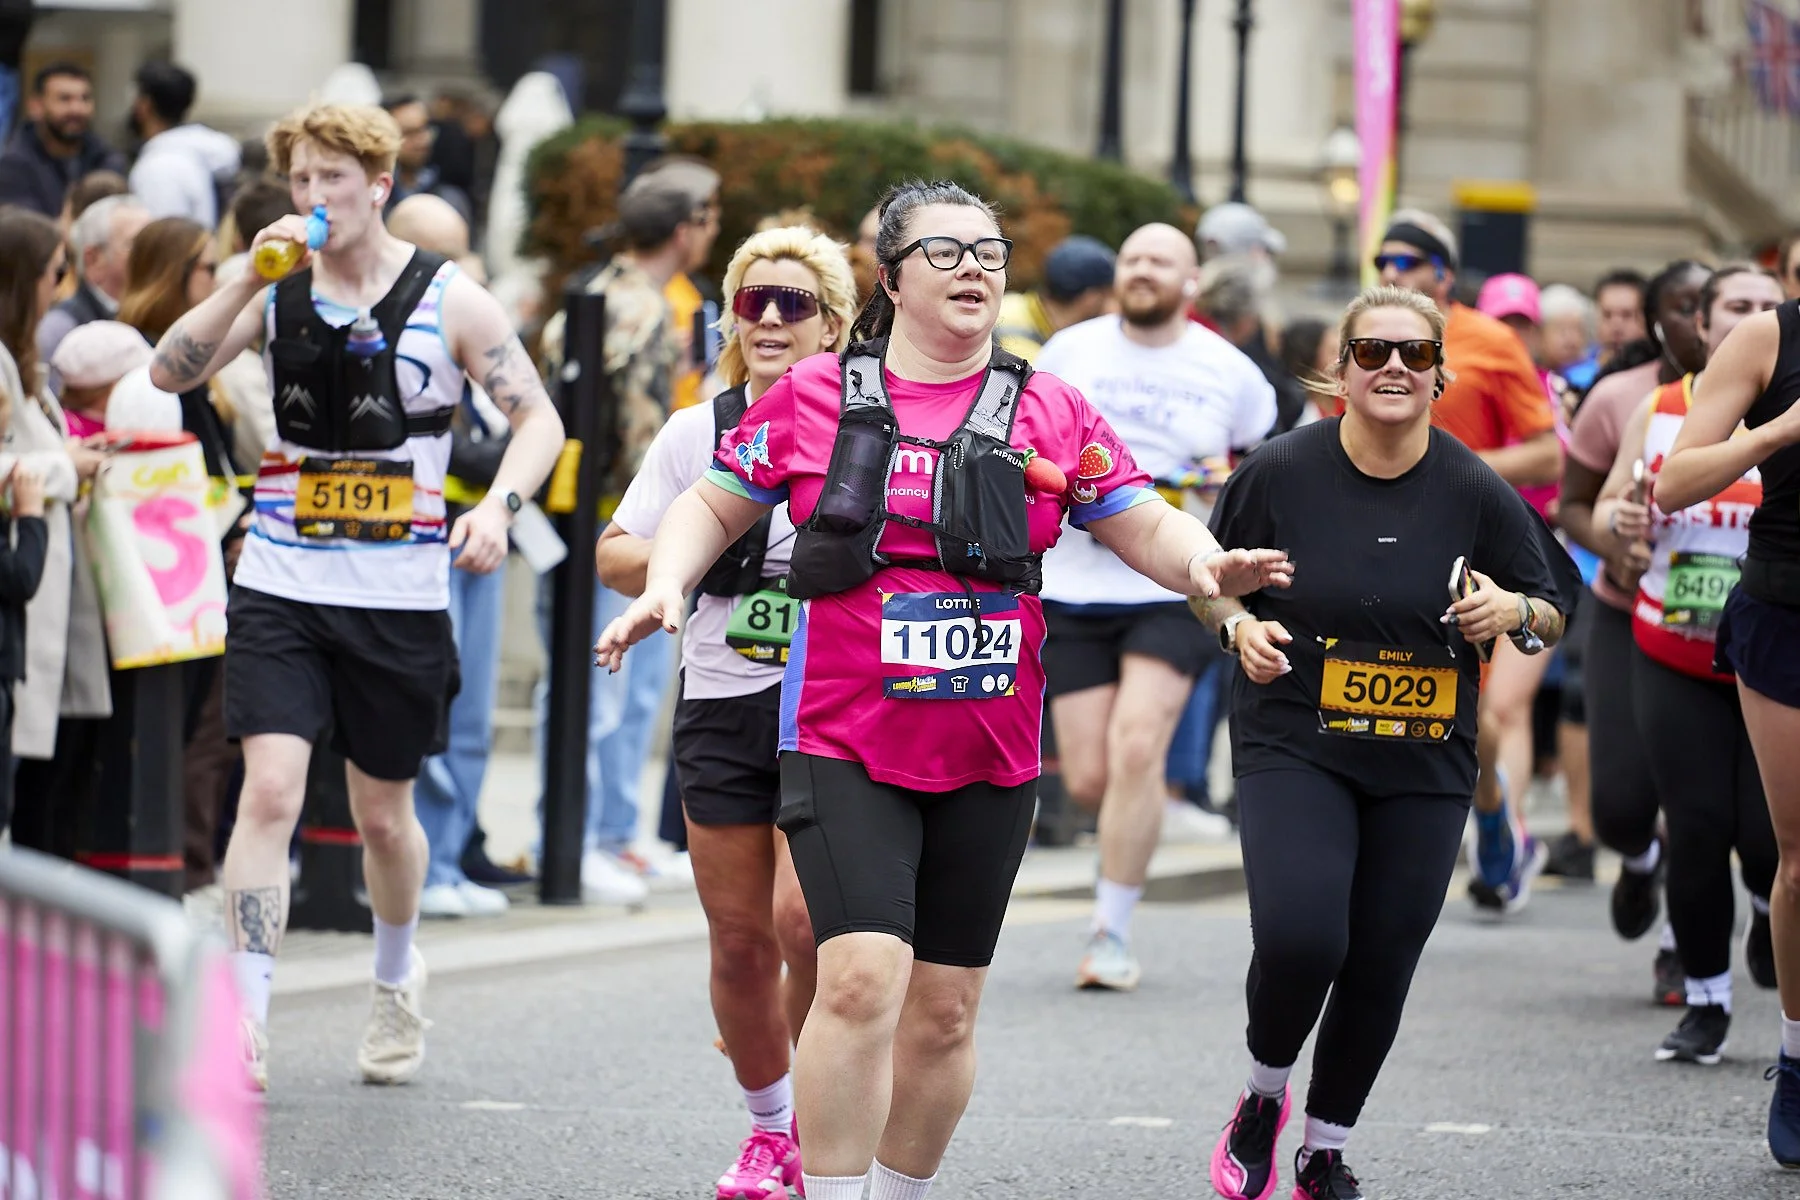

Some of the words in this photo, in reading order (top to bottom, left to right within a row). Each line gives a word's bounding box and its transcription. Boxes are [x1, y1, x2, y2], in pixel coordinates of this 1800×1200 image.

[992, 447, 1025, 470] KIPRUN
[312, 482, 389, 511] 5191
[1674, 571, 1736, 600] 649
[893, 624, 1013, 660] 11024
[1379, 650, 1413, 661] EMILY
[1343, 670, 1438, 708] 5029
